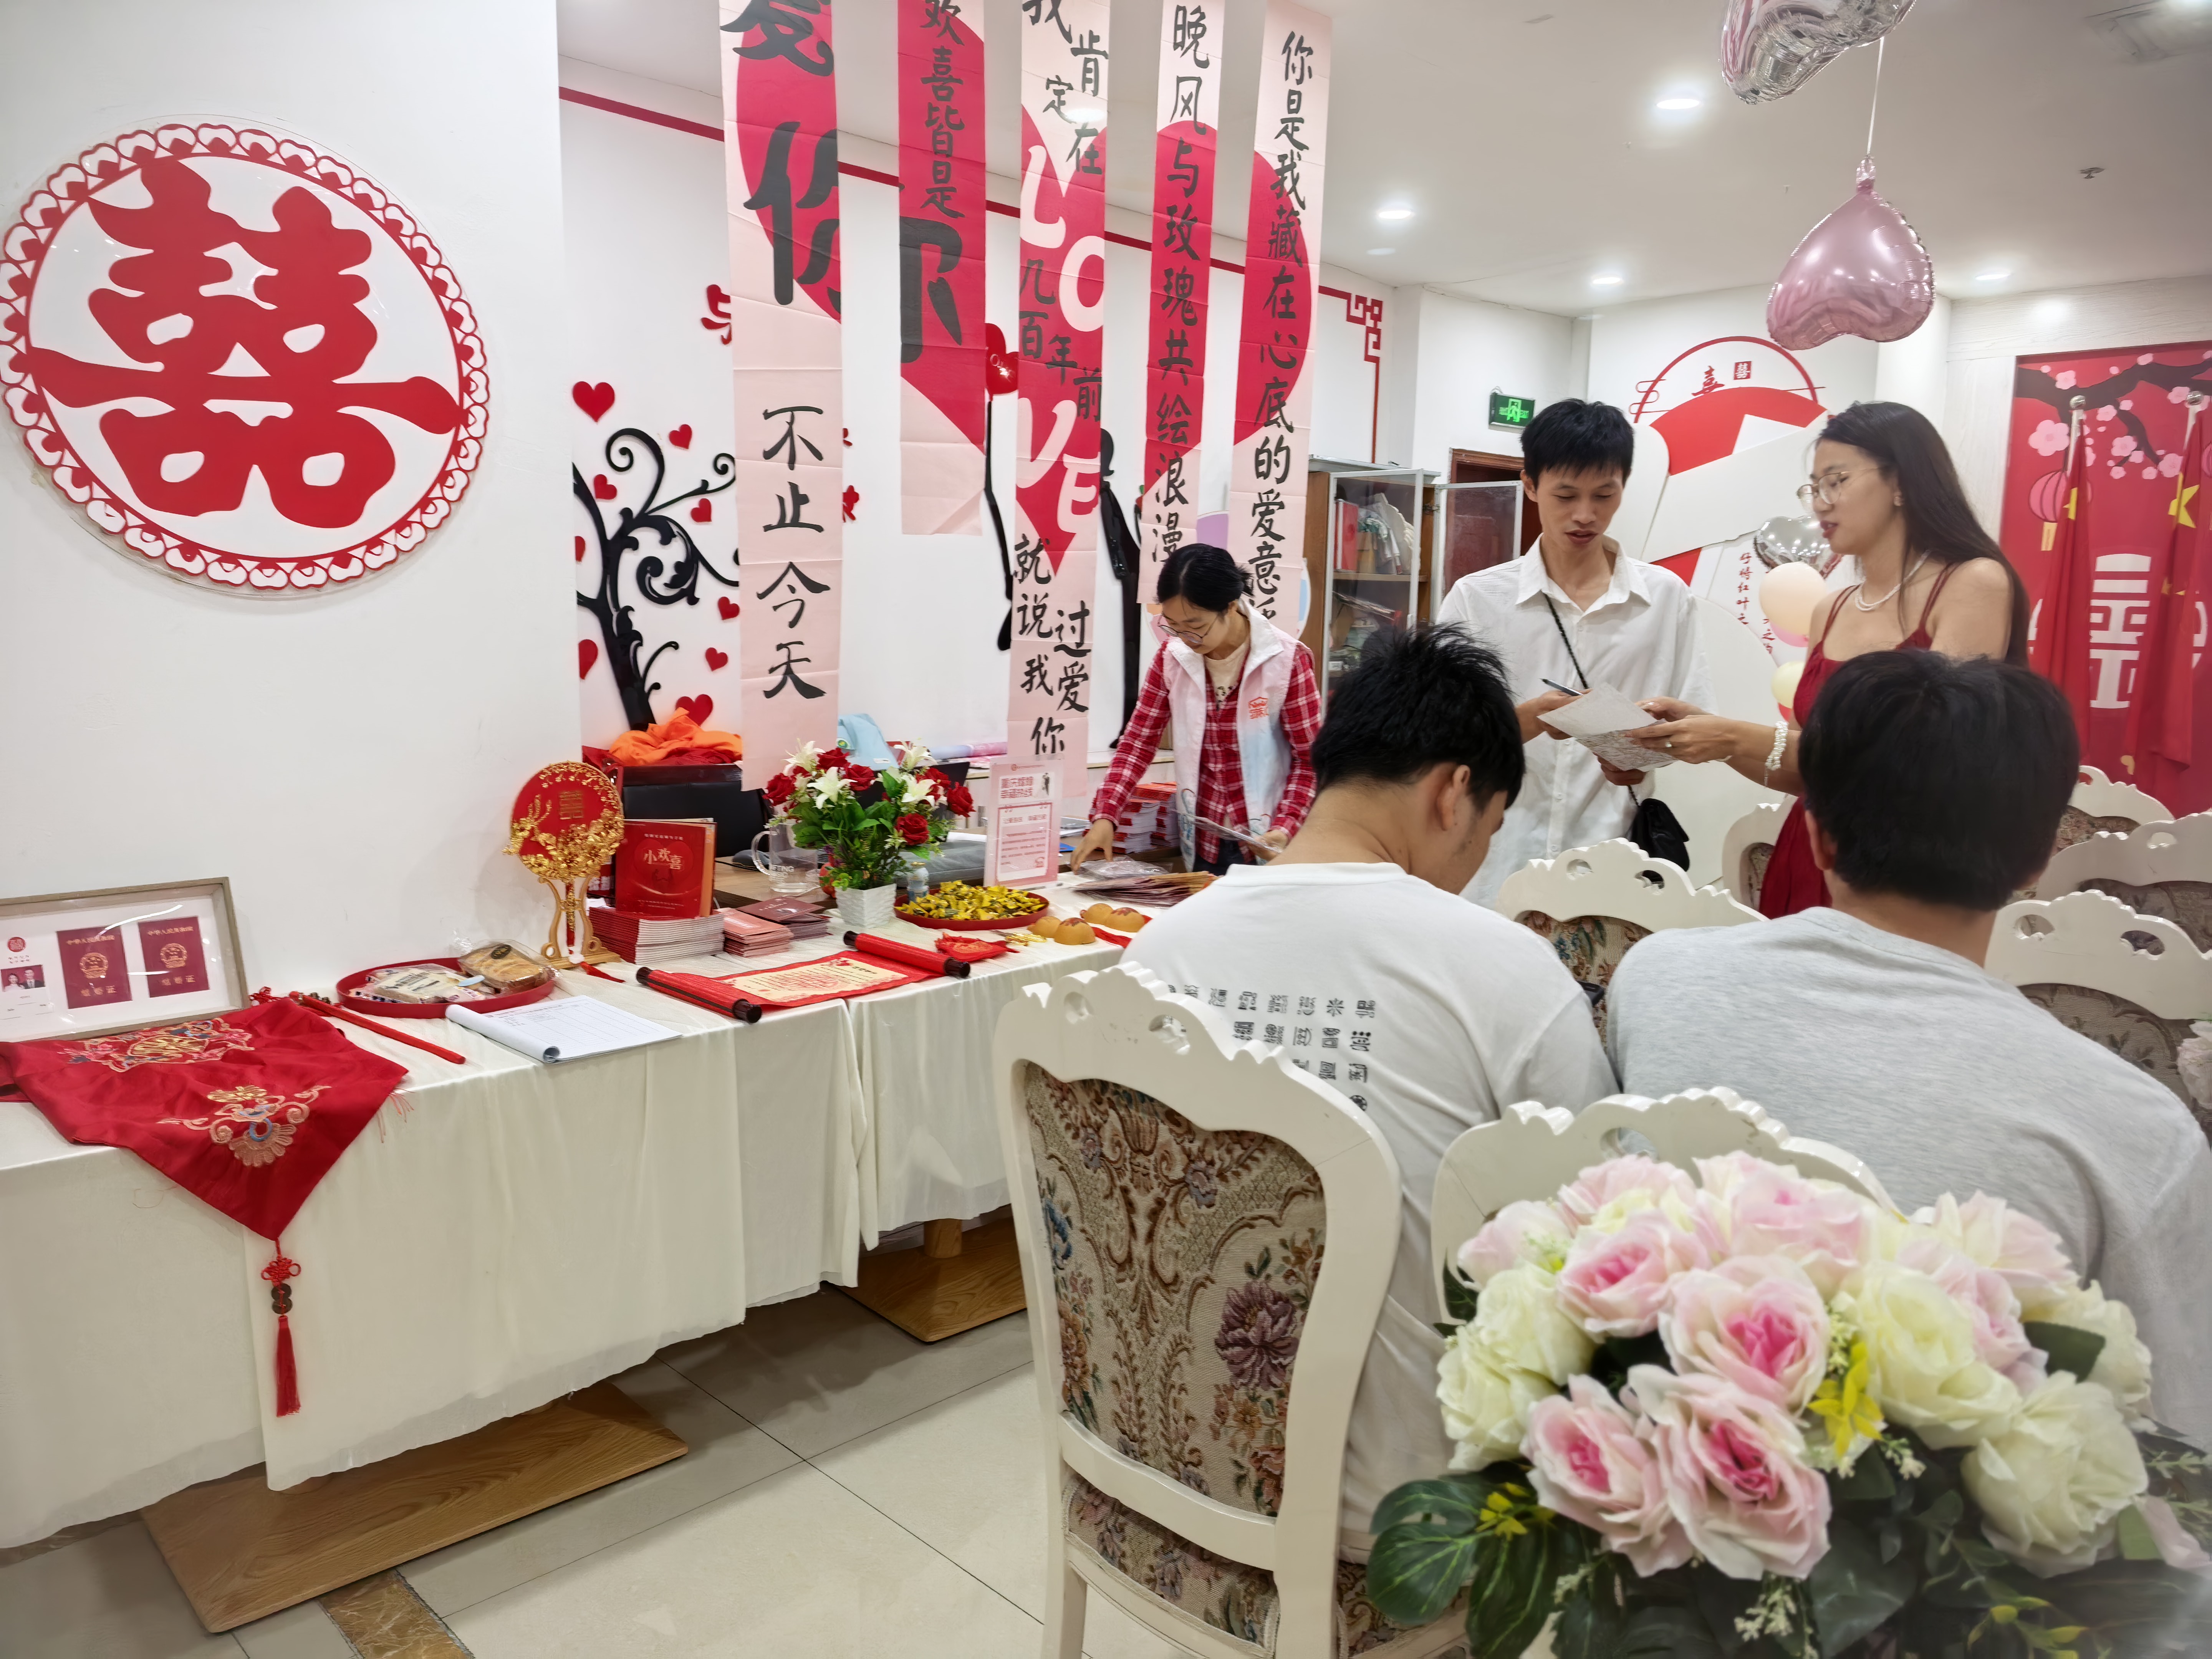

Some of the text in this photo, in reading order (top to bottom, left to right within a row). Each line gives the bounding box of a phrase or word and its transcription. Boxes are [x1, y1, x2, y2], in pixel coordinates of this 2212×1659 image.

[757, 406, 831, 699] 不止今天
[643, 848, 684, 870] 小欢喜
